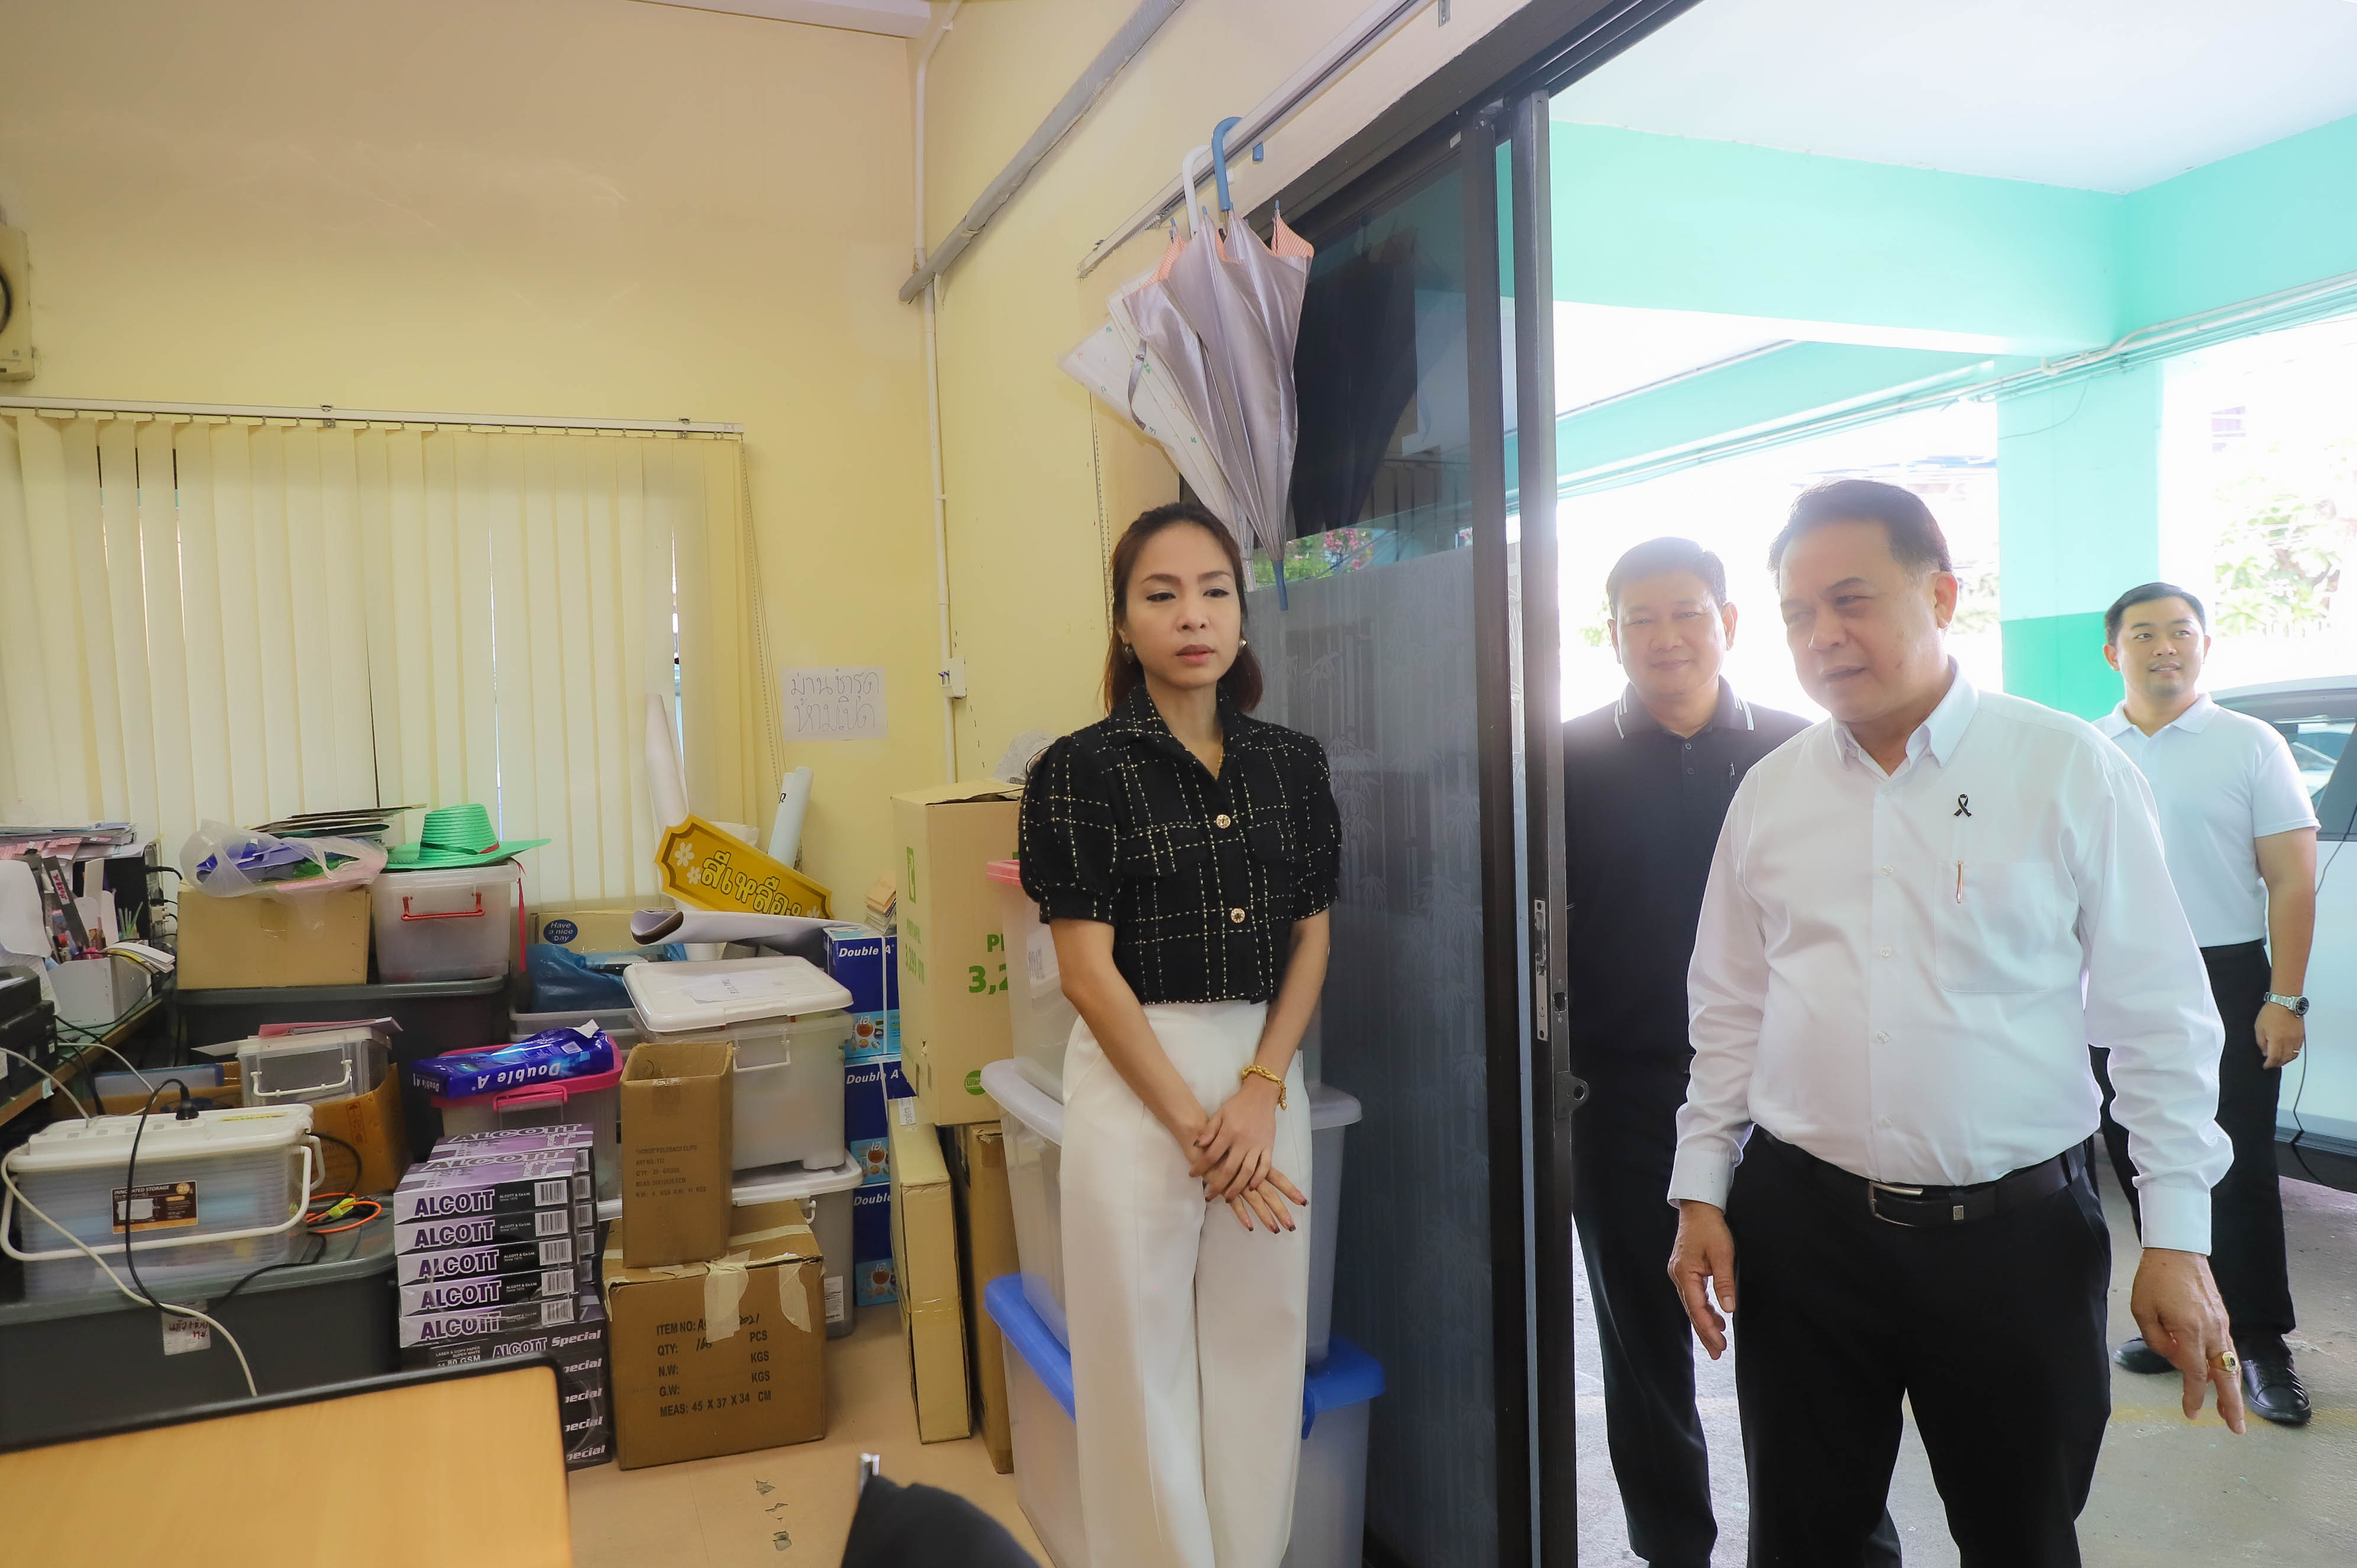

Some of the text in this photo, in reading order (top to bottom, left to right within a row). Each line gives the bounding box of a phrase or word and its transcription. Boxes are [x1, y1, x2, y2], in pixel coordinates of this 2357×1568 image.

[838, 945, 891, 957] Double A
[422, 1079, 440, 1092] Double
[477, 1062, 561, 1089] Double A
[890, 1069, 899, 1079] A
[448, 1124, 582, 1143] ALCOTT
[419, 1149, 565, 1173] ALCOTT
[414, 1189, 495, 1218] ALCOTT
[414, 1220, 495, 1249] ALCOTT
[418, 1249, 499, 1279] ALCOTT
[421, 1281, 502, 1310] ALCOTT
[420, 1311, 502, 1341] ALCOTT
[656, 1322, 678, 1336] ITEM
[680, 1320, 696, 1333] NO:
[492, 1330, 601, 1359] ALCOTT Special
[657, 1343, 679, 1356] QTY:
[750, 1330, 768, 1343] PCS
[460, 1355, 480, 1364] GSM
[751, 1351, 769, 1363] KGS
[751, 1370, 770, 1383] KGS
[660, 1390, 771, 1417] MEAS: 45 X 37 X 34 CM
